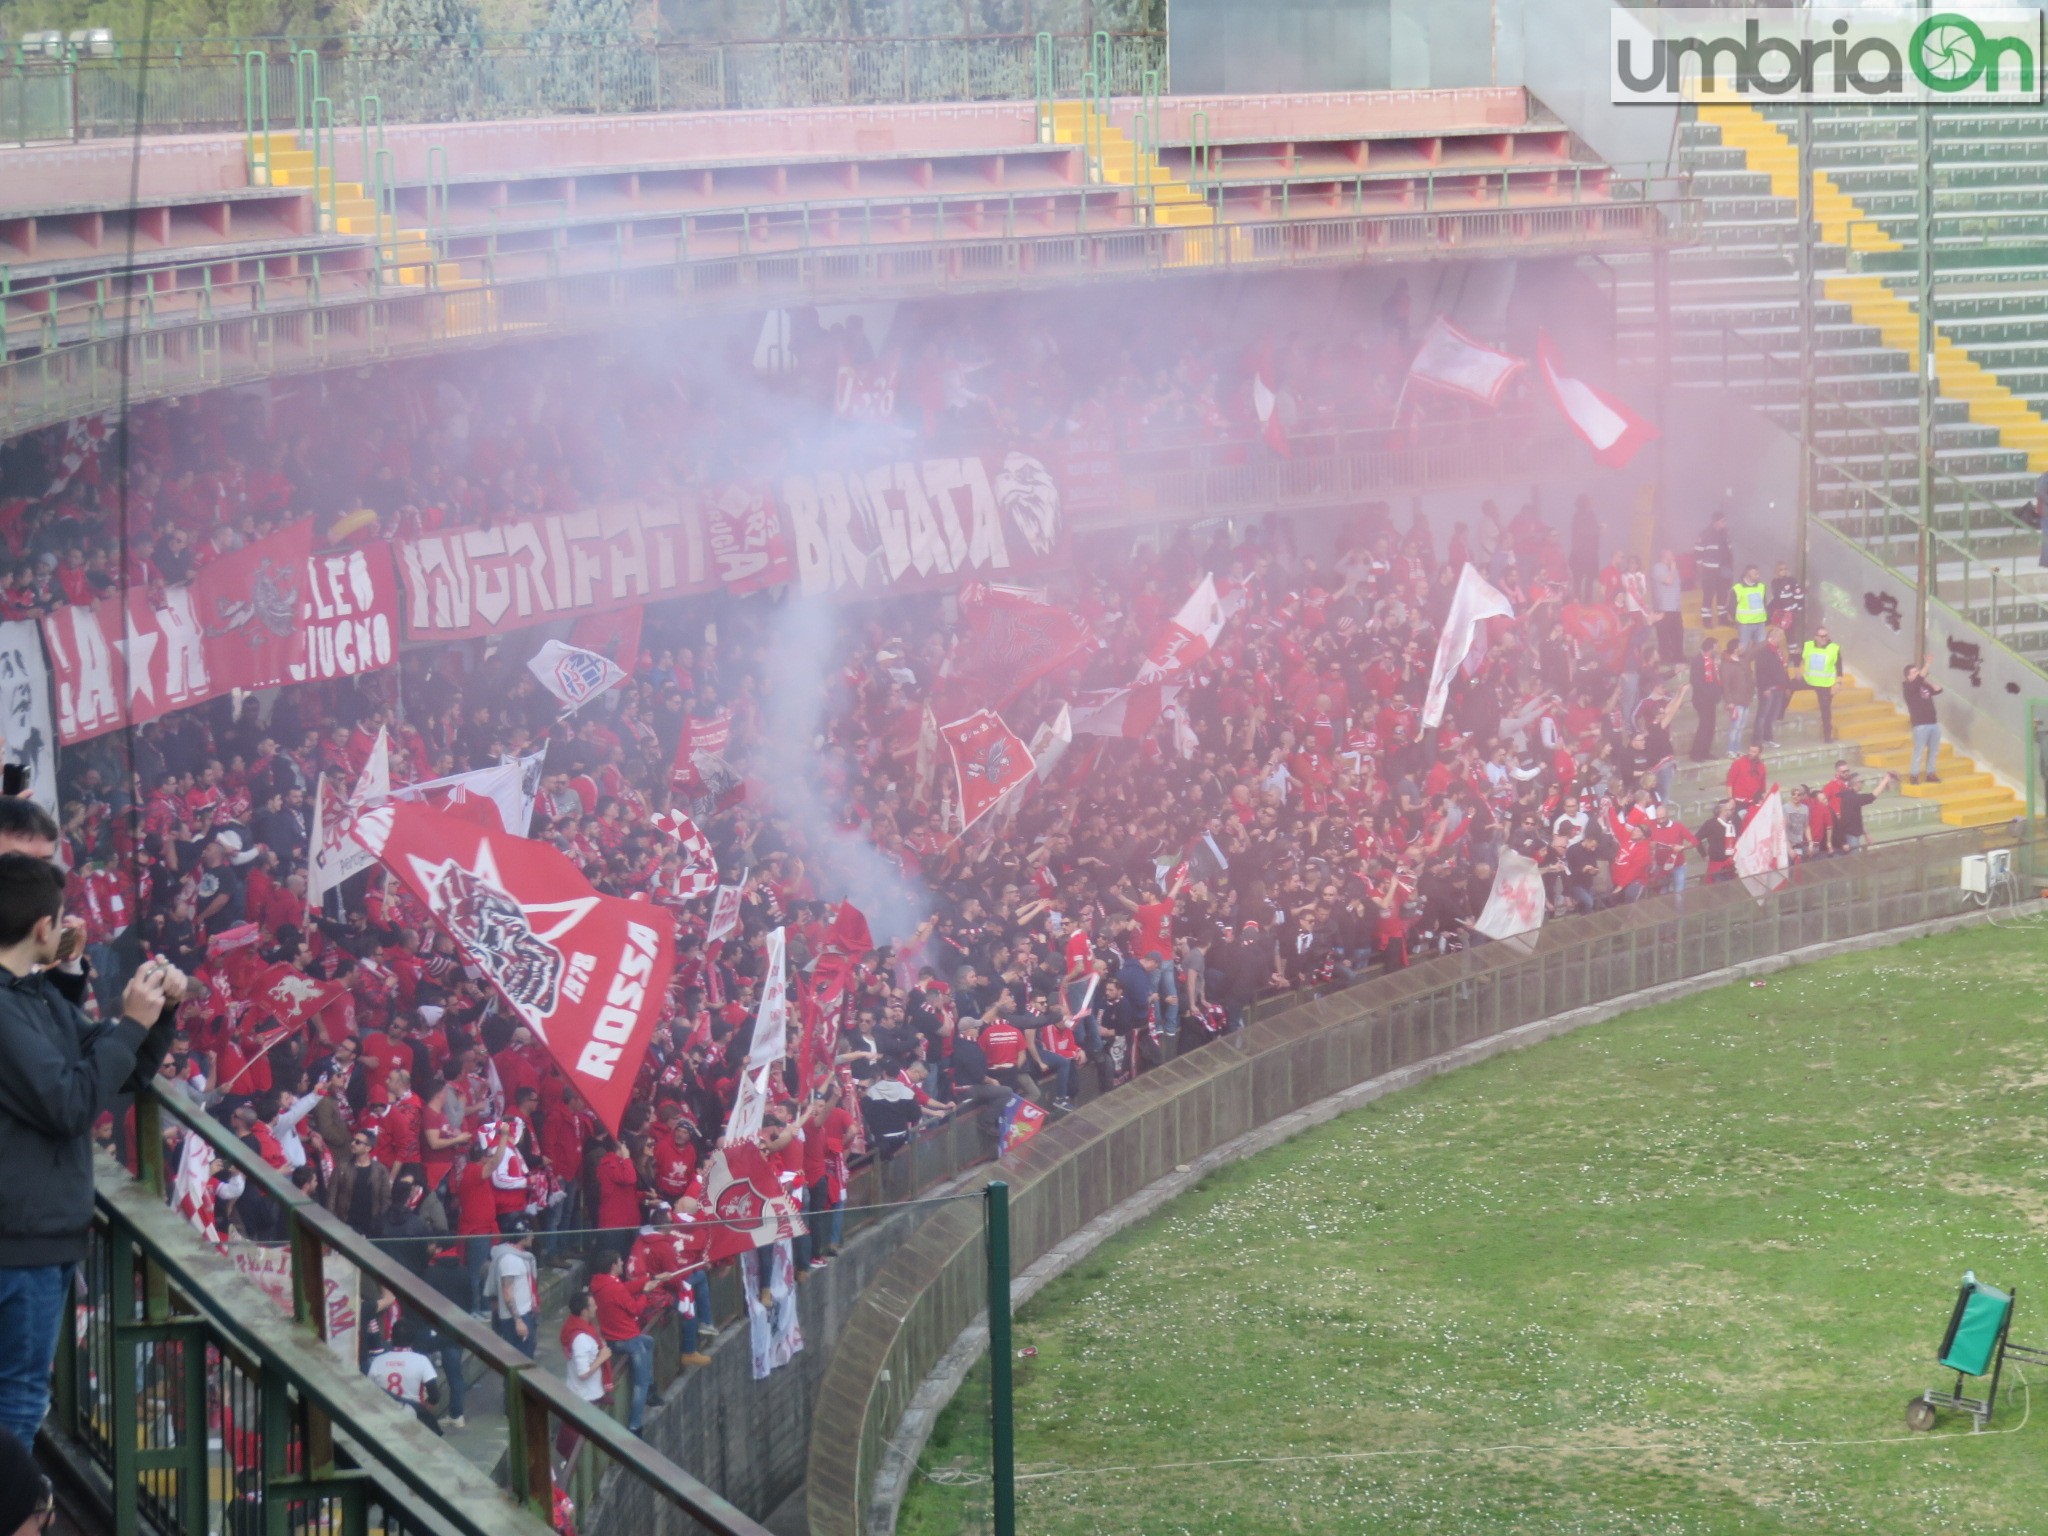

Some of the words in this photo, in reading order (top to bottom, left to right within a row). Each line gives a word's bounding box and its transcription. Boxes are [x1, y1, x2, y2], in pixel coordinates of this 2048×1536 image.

[561, 951, 597, 1004] 1978
[576, 920, 659, 1081] ROSSA
[387, 1372, 404, 1398] 8
